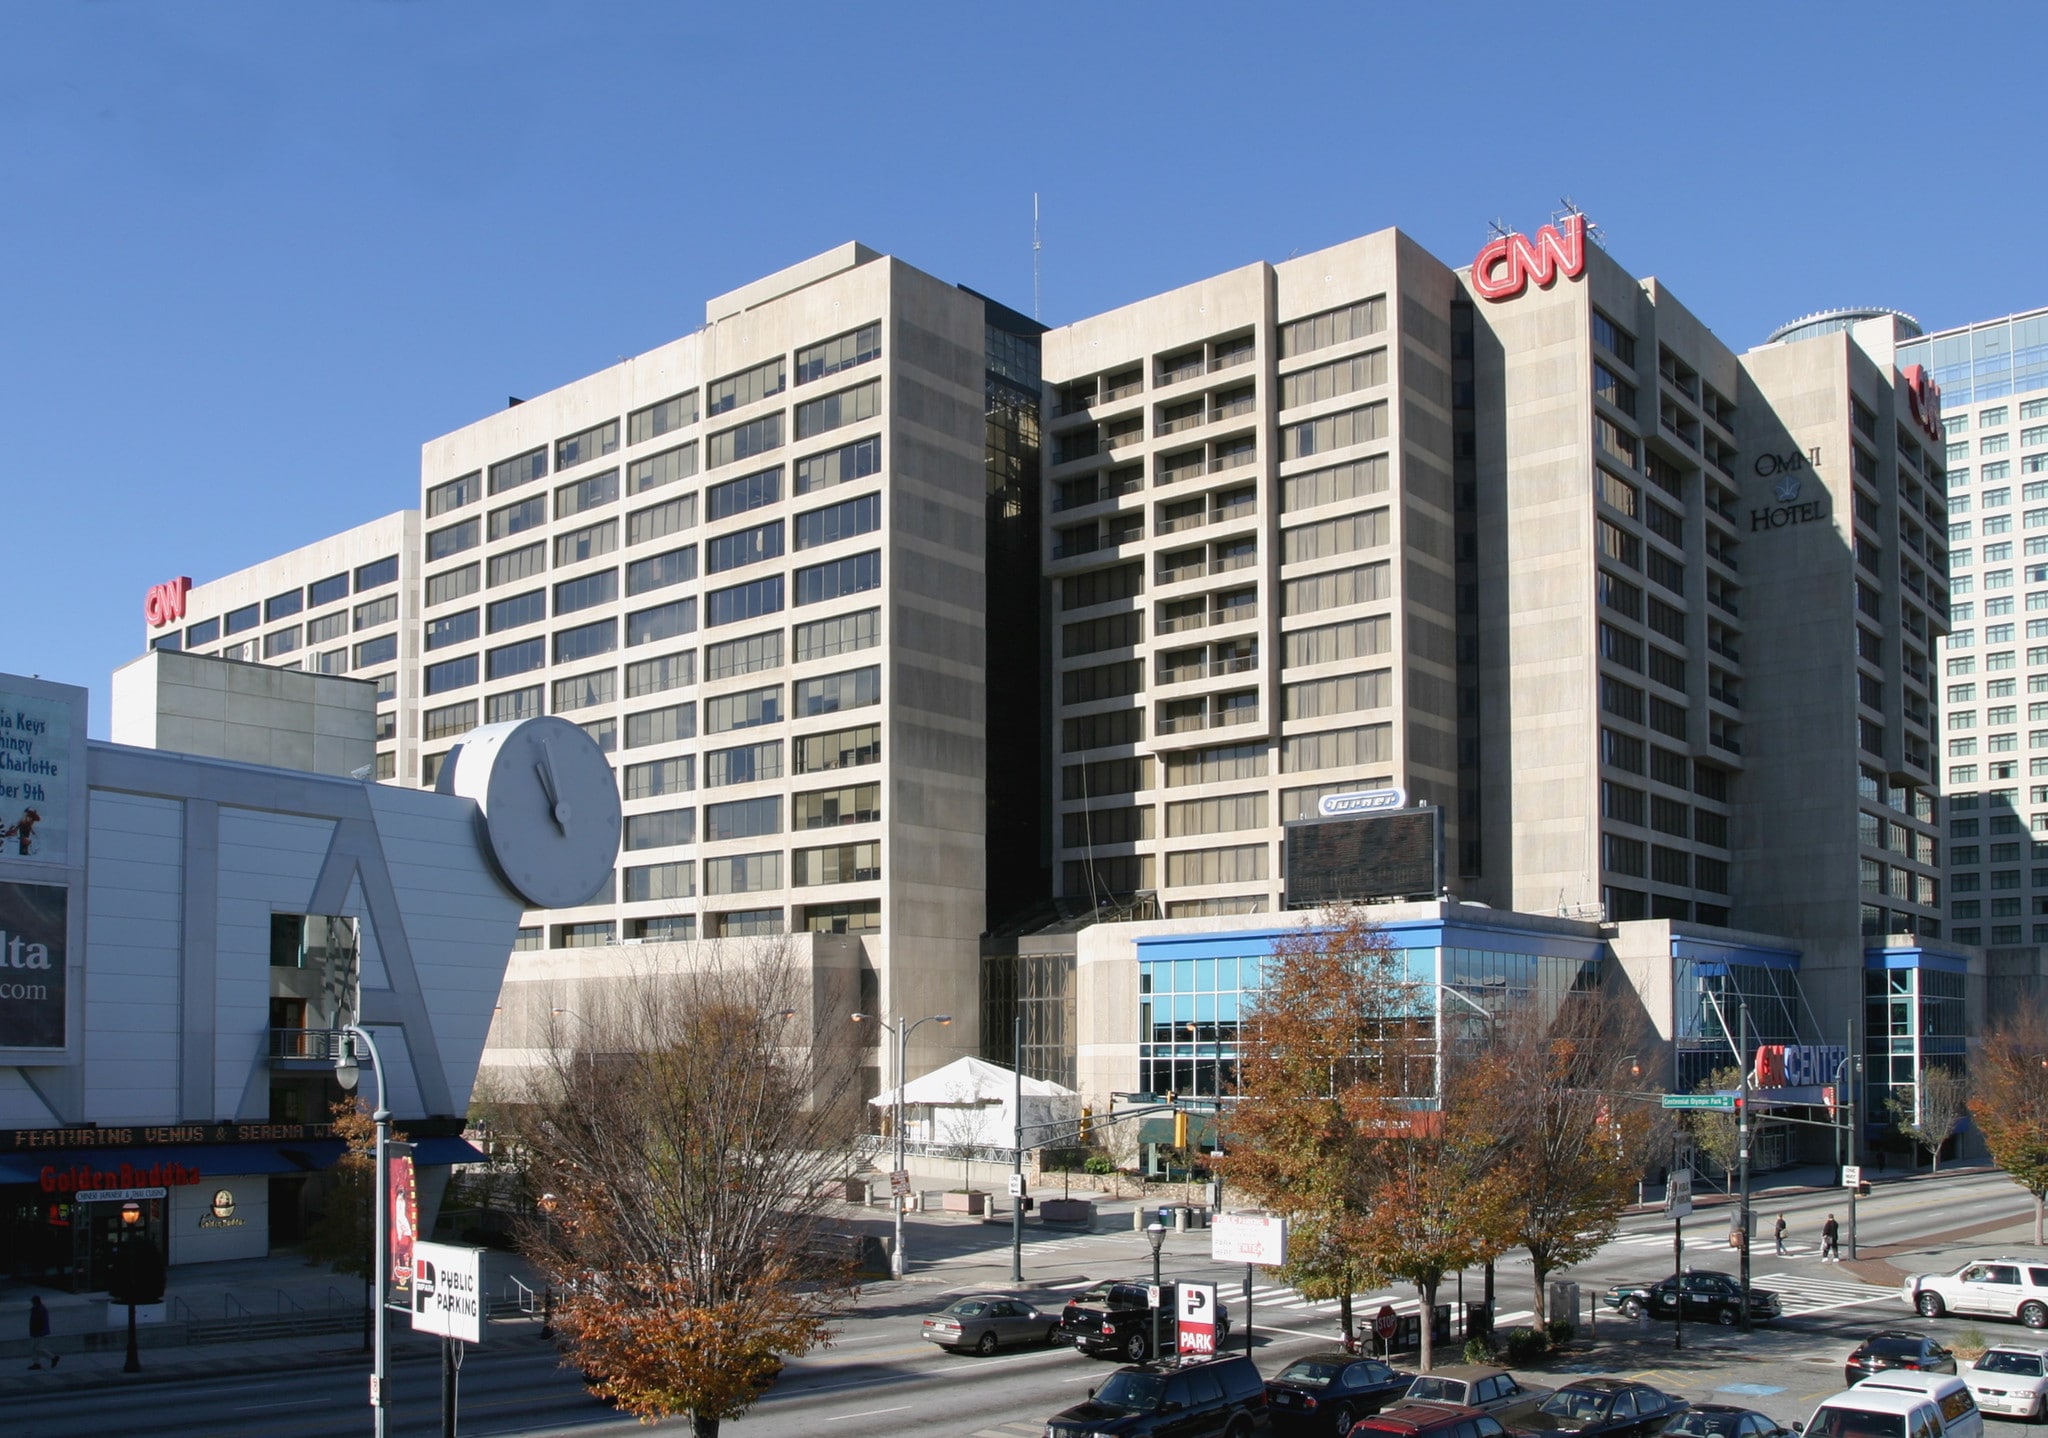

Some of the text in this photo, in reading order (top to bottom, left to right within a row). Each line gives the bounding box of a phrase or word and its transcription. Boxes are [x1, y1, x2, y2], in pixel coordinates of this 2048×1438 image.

[1472, 216, 1584, 298] CNN
[1755, 447, 1821, 477] OMNI
[1750, 501, 1827, 532] HOTEL
[145, 576, 186, 626] CNN
[17, 712, 46, 735] Keys
[24, 783, 45, 801] 9th
[16, 1129, 133, 1146] FEATURING
[145, 1127, 204, 1142] VENUS
[216, 1126, 227, 1141] &
[239, 1125, 304, 1140] SERENA
[441, 1270, 473, 1292] PUBLIC
[437, 1293, 477, 1317] PARKING
[1377, 1314, 1396, 1329] STOP
[1181, 1331, 1213, 1350] PARK
